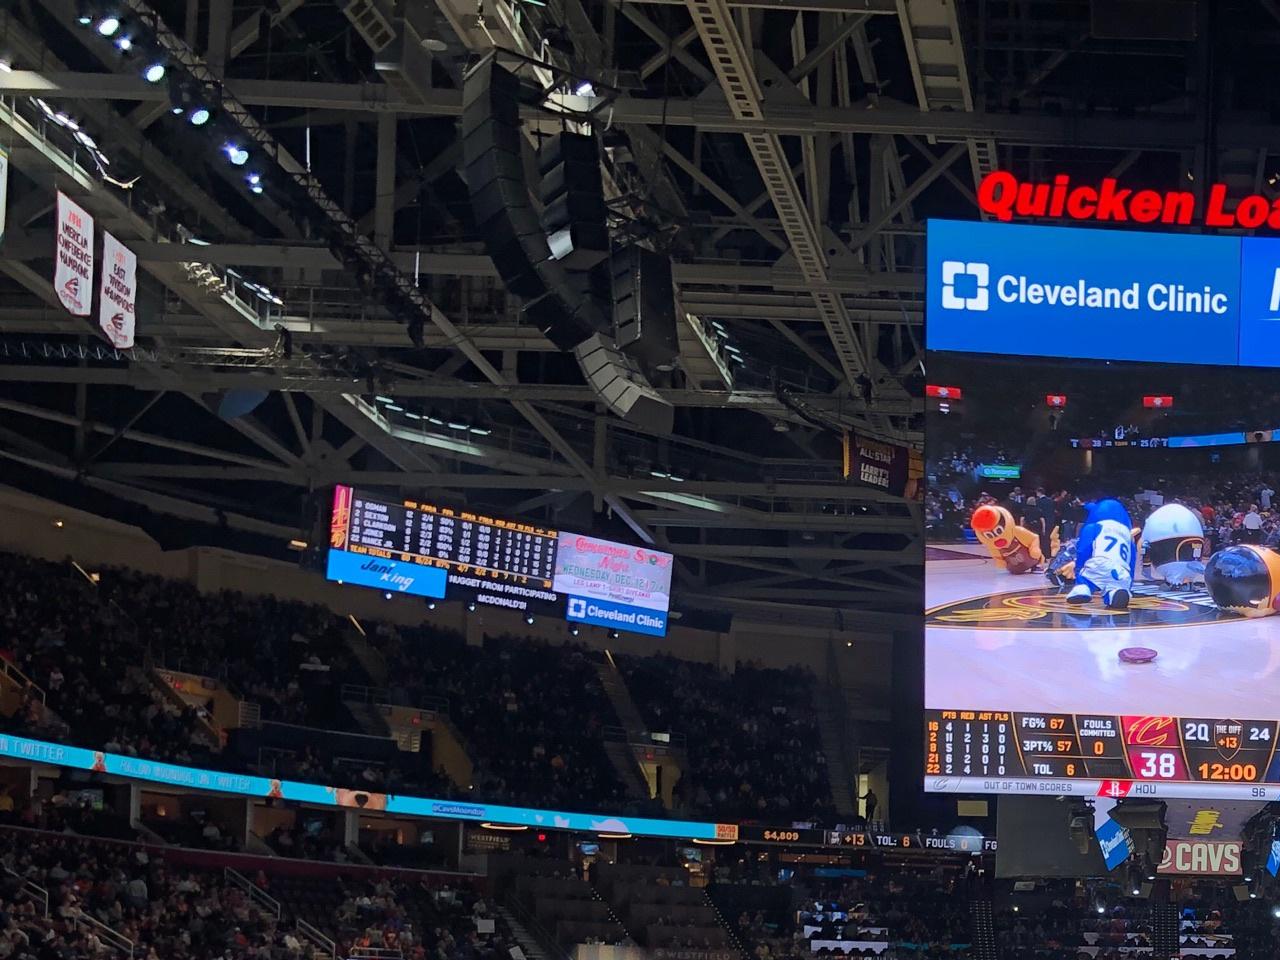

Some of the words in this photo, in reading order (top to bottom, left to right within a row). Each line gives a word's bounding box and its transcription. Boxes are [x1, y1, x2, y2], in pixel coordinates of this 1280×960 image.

[977, 171, 1194, 226] Quicken
[997, 274, 1140, 310] Cleveland
[1148, 284, 1228, 315] Clinic
[1104, 536, 1129, 562] 76
[449, 575, 481, 588] NUGGET
[481, 580, 504, 593] FROM
[504, 585, 557, 602] PARTICIPATING
[587, 605, 636, 625] Cleveland
[636, 614, 664, 629] Clinic
[942, 711, 957, 720] PTS
[960, 712, 975, 720] REB
[978, 712, 993, 720] AST
[994, 713, 1009, 721] FLS
[1022, 717, 1046, 729] FG%
[1050, 718, 1065, 730] 67
[1084, 720, 1112, 729] FOULS
[1216, 725, 1228, 734] THE
[1228, 725, 1242, 735] DIFF
[1080, 729, 1115, 738] COMMITTED
[1185, 723, 1210, 742] 2Q
[1249, 727, 1271, 741] 24
[1023, 740, 1053, 753] 3PT%
[1057, 740, 1072, 752] 57
[1094, 741, 1104, 755] 0
[1218, 737, 1238, 749] +13
[1033, 764, 1053, 776] TOL
[1066, 764, 1075, 776] 6
[1141, 752, 1175, 778] 38
[1198, 763, 1257, 781] 12:00
[984, 781, 1001, 790] OUT
[1002, 781, 1013, 790] OF
[1015, 782, 1037, 791] TOWN
[1039, 782, 1073, 792] SCORES
[1135, 784, 1157, 795] HOU
[1251, 787, 1266, 798] 96
[845, 834, 865, 846] +13
[876, 835, 897, 846] TOL:
[902, 836, 910, 847] 6
[926, 838, 956, 849] FOULS
[960, 839, 968, 850] 0
